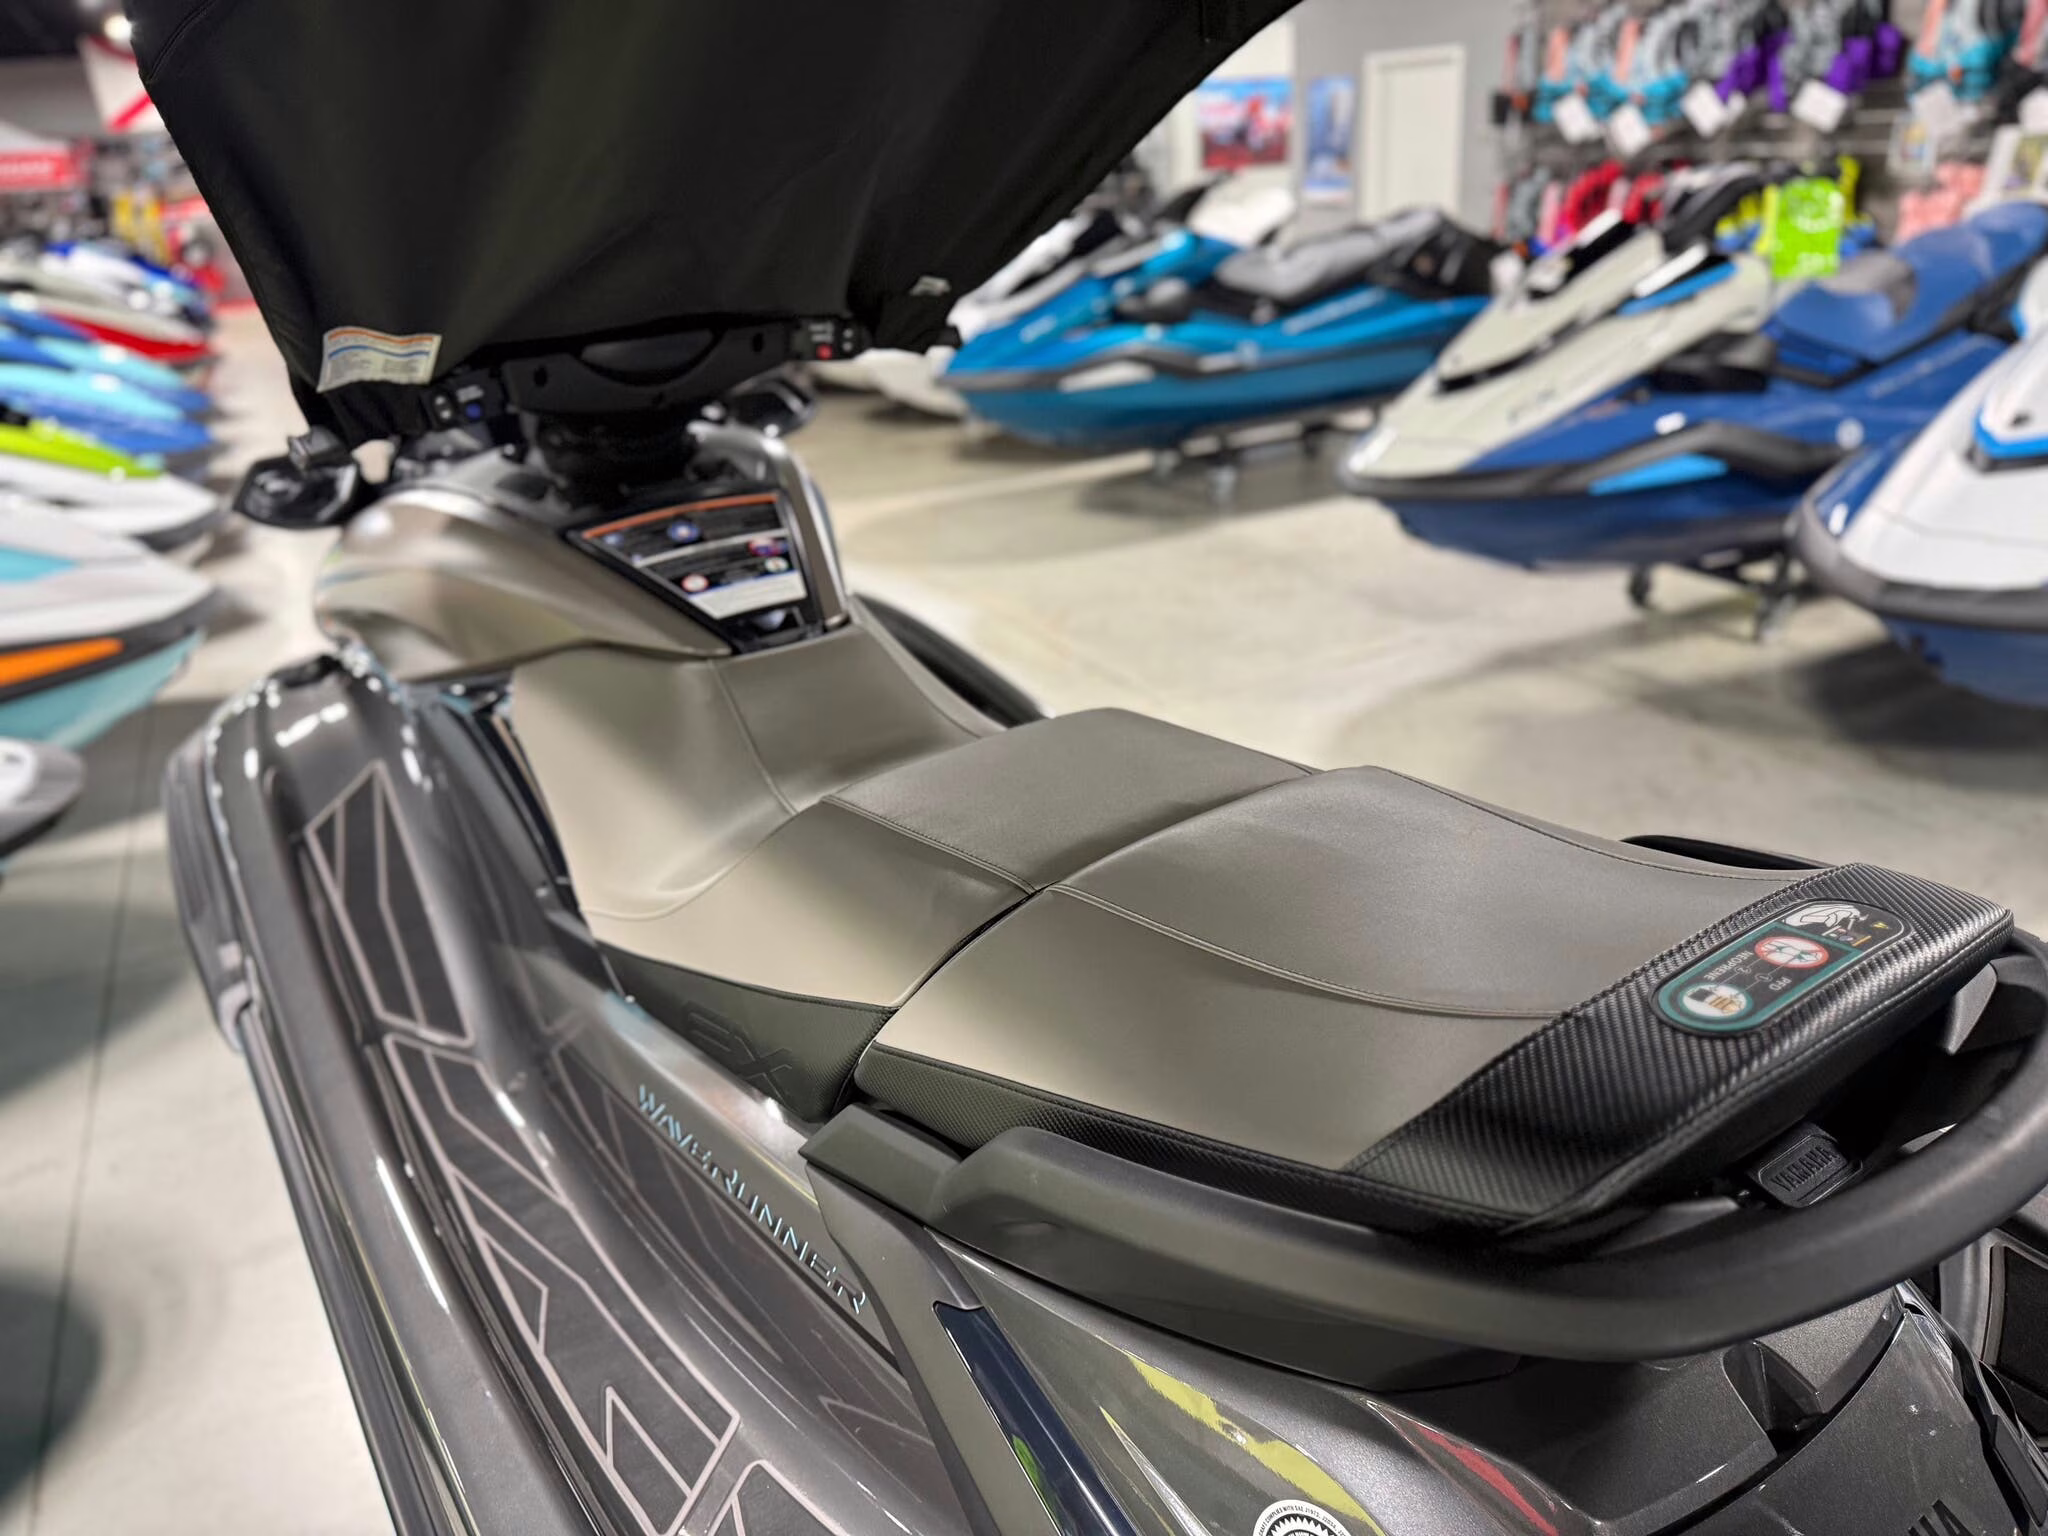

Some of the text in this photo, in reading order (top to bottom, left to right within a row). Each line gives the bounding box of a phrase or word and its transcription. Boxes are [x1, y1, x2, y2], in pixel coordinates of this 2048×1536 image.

[1703, 950, 1753, 981] NEOPRENE
[1769, 976, 1792, 991] PFD
[1770, 1146, 1838, 1192] YAMAHA
[637, 1083, 867, 1316] WAVERUNNER
